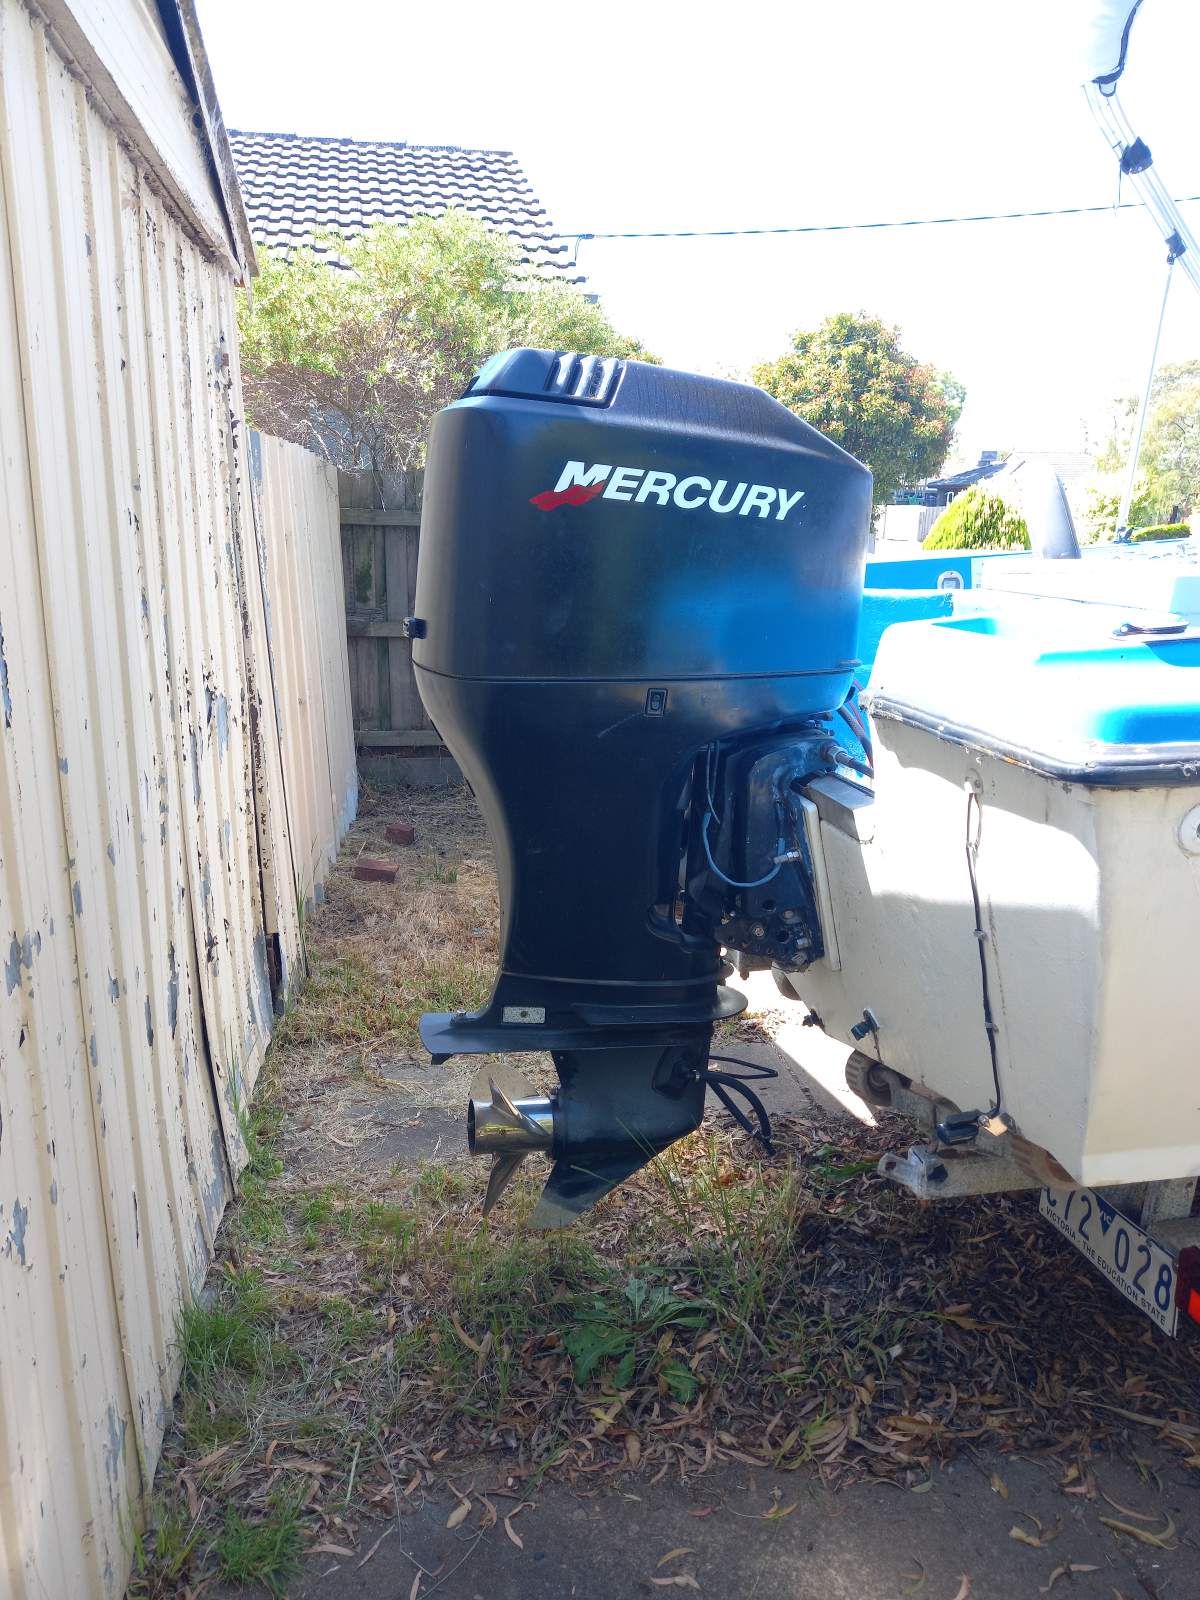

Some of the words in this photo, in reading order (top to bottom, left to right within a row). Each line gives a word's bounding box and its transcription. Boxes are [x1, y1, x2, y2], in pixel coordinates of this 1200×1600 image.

[553, 460, 805, 521] MERCURY
[1046, 1206, 1076, 1241] VICTORIA
[1082, 1240, 1096, 1259] THE
[1097, 1255, 1138, 1301] EDUCATION
[1141, 1297, 1166, 1326] STATE
